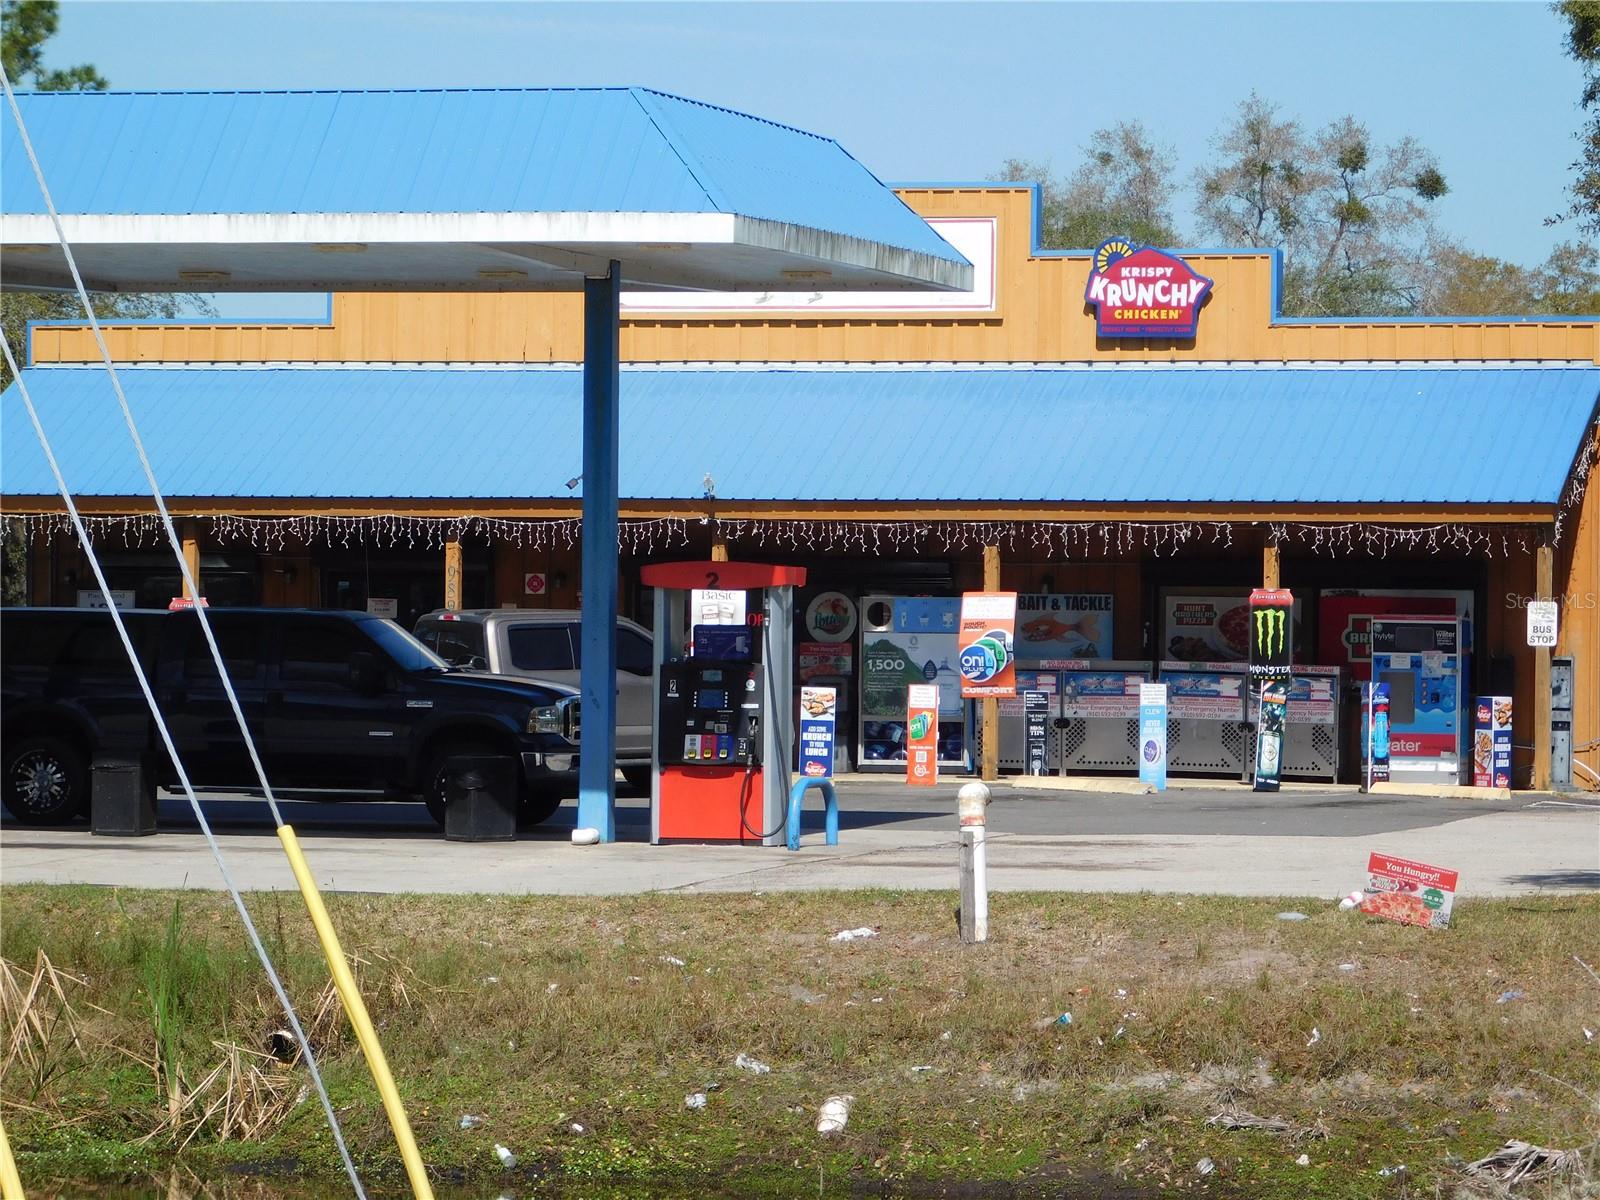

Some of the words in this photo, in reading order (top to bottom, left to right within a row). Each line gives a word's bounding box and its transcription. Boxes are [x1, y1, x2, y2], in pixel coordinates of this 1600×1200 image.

[1121, 267, 1173, 277] KRISPY
[1090, 275, 1205, 307] KRUNCHY
[1114, 309, 1179, 319] CHICKEN
[706, 572, 719, 587] 2
[702, 590, 736, 600] Basic
[1018, 596, 1048, 610] BAIT
[1052, 597, 1061, 610] &
[1064, 596, 1111, 610] TACKLE
[1532, 625, 1552, 634] BUS
[1530, 635, 1554, 643] STOP
[867, 659, 905, 672] 1,500
[1249, 665, 1291, 675] MONSTER
[1390, 740, 1421, 752] ater
[805, 748, 828, 756] LUNCH
[1386, 862, 1402, 872] You
[1403, 867, 1440, 881] Hungry!!
